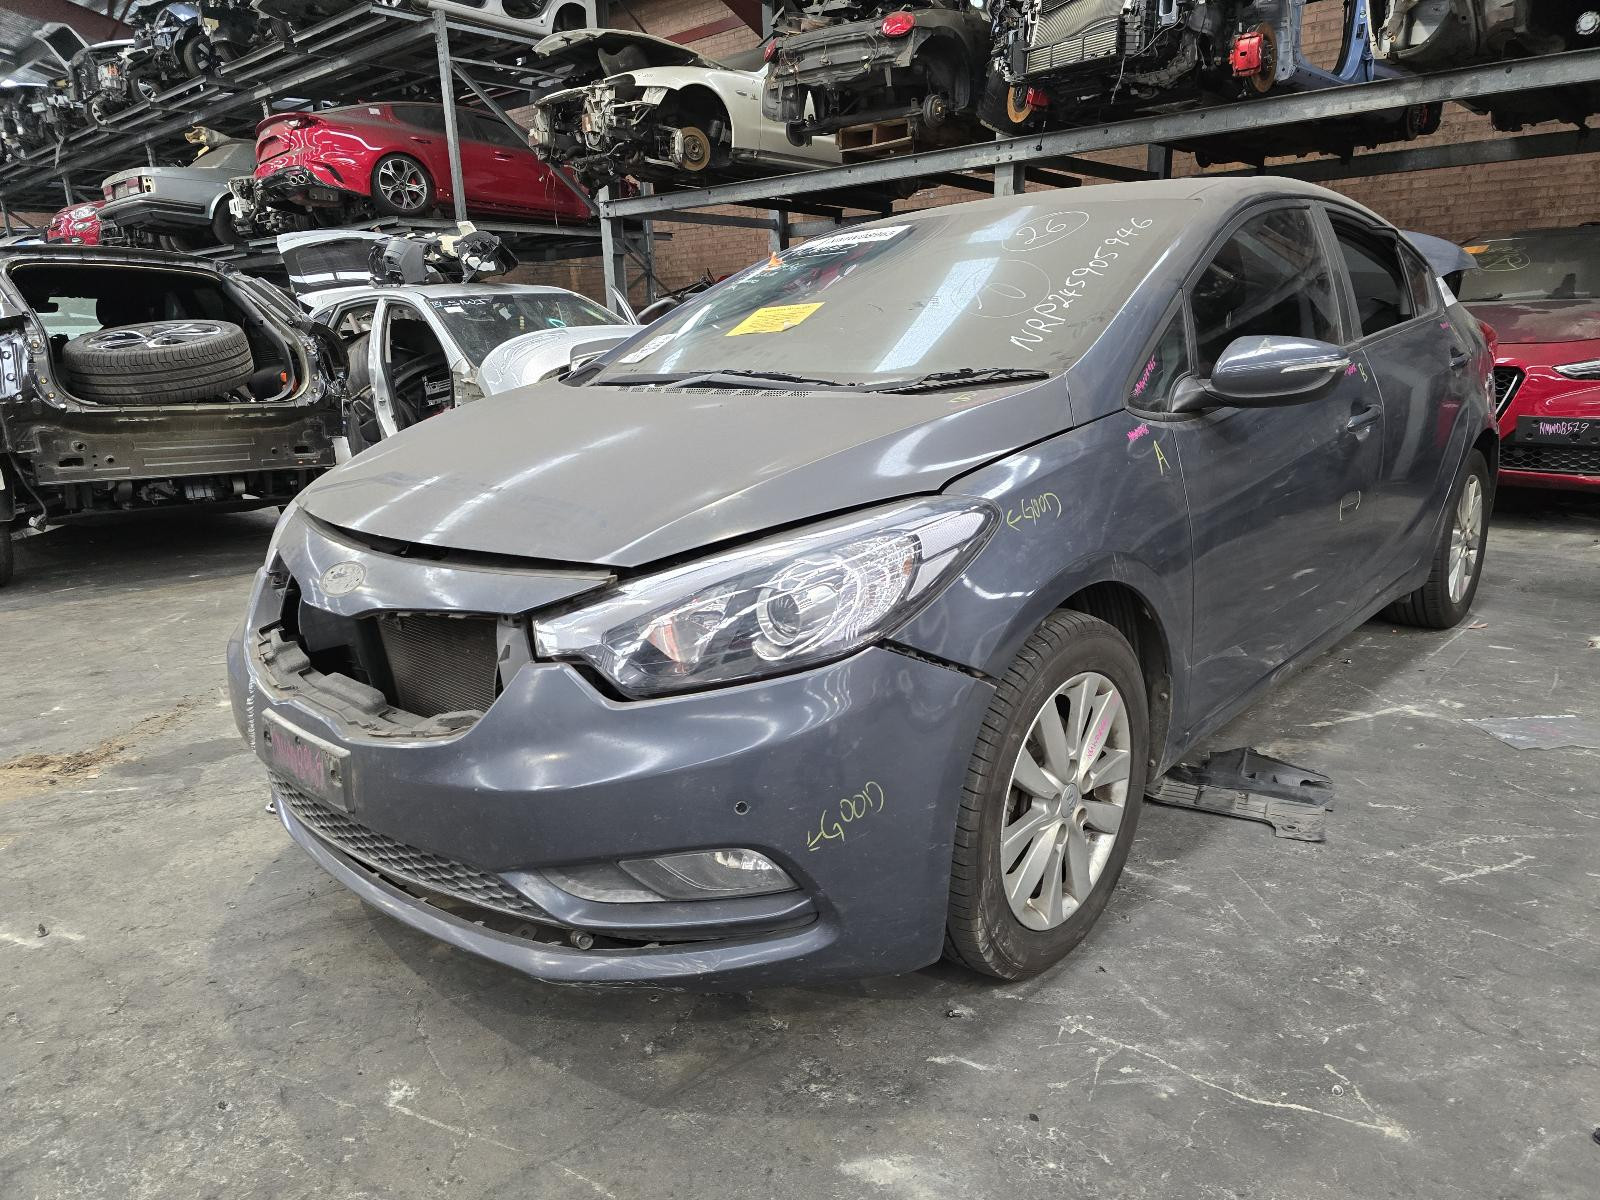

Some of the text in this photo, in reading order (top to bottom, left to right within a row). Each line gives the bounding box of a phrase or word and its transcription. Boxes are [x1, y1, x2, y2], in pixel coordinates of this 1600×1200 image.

[1016, 219, 1067, 245] 26
[1153, 439, 1171, 476] A
[820, 780, 885, 842] GOOD
